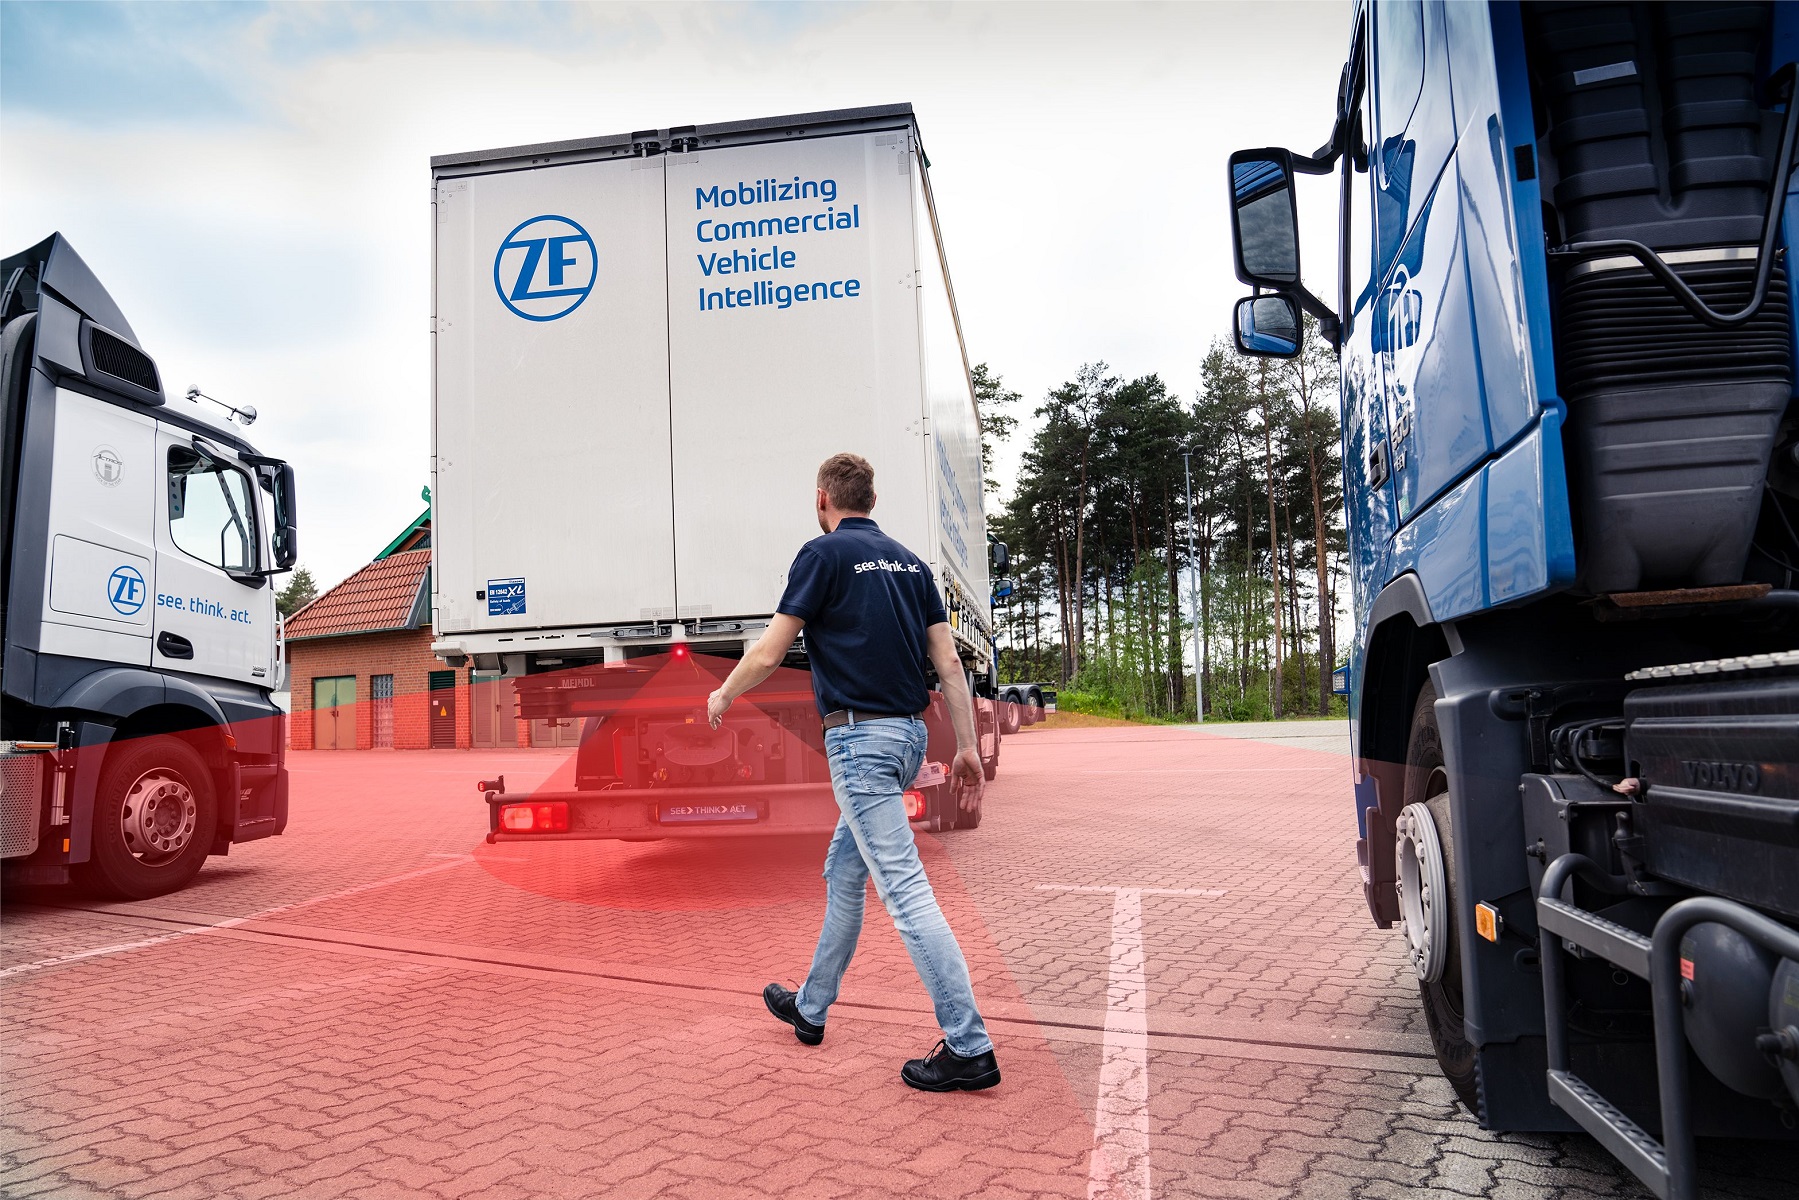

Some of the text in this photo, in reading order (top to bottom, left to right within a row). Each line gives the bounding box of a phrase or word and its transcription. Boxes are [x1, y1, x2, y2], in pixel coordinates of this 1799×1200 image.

[695, 176, 837, 210] Mobilizing
[696, 204, 860, 243] Commercial
[502, 234, 590, 304] ZF
[697, 246, 796, 276] Vehicle
[699, 277, 861, 312] Intelligence
[854, 561, 879, 574] see.
[907, 564, 921, 573] ac
[111, 572, 144, 607] ZF
[507, 585, 524, 598] XL
[157, 593, 252, 624] see. think. act.
[562, 678, 595, 689] MEINDL
[1681, 760, 1758, 789] VOLVO
[670, 807, 687, 815] SEE
[695, 806, 721, 814] THINK
